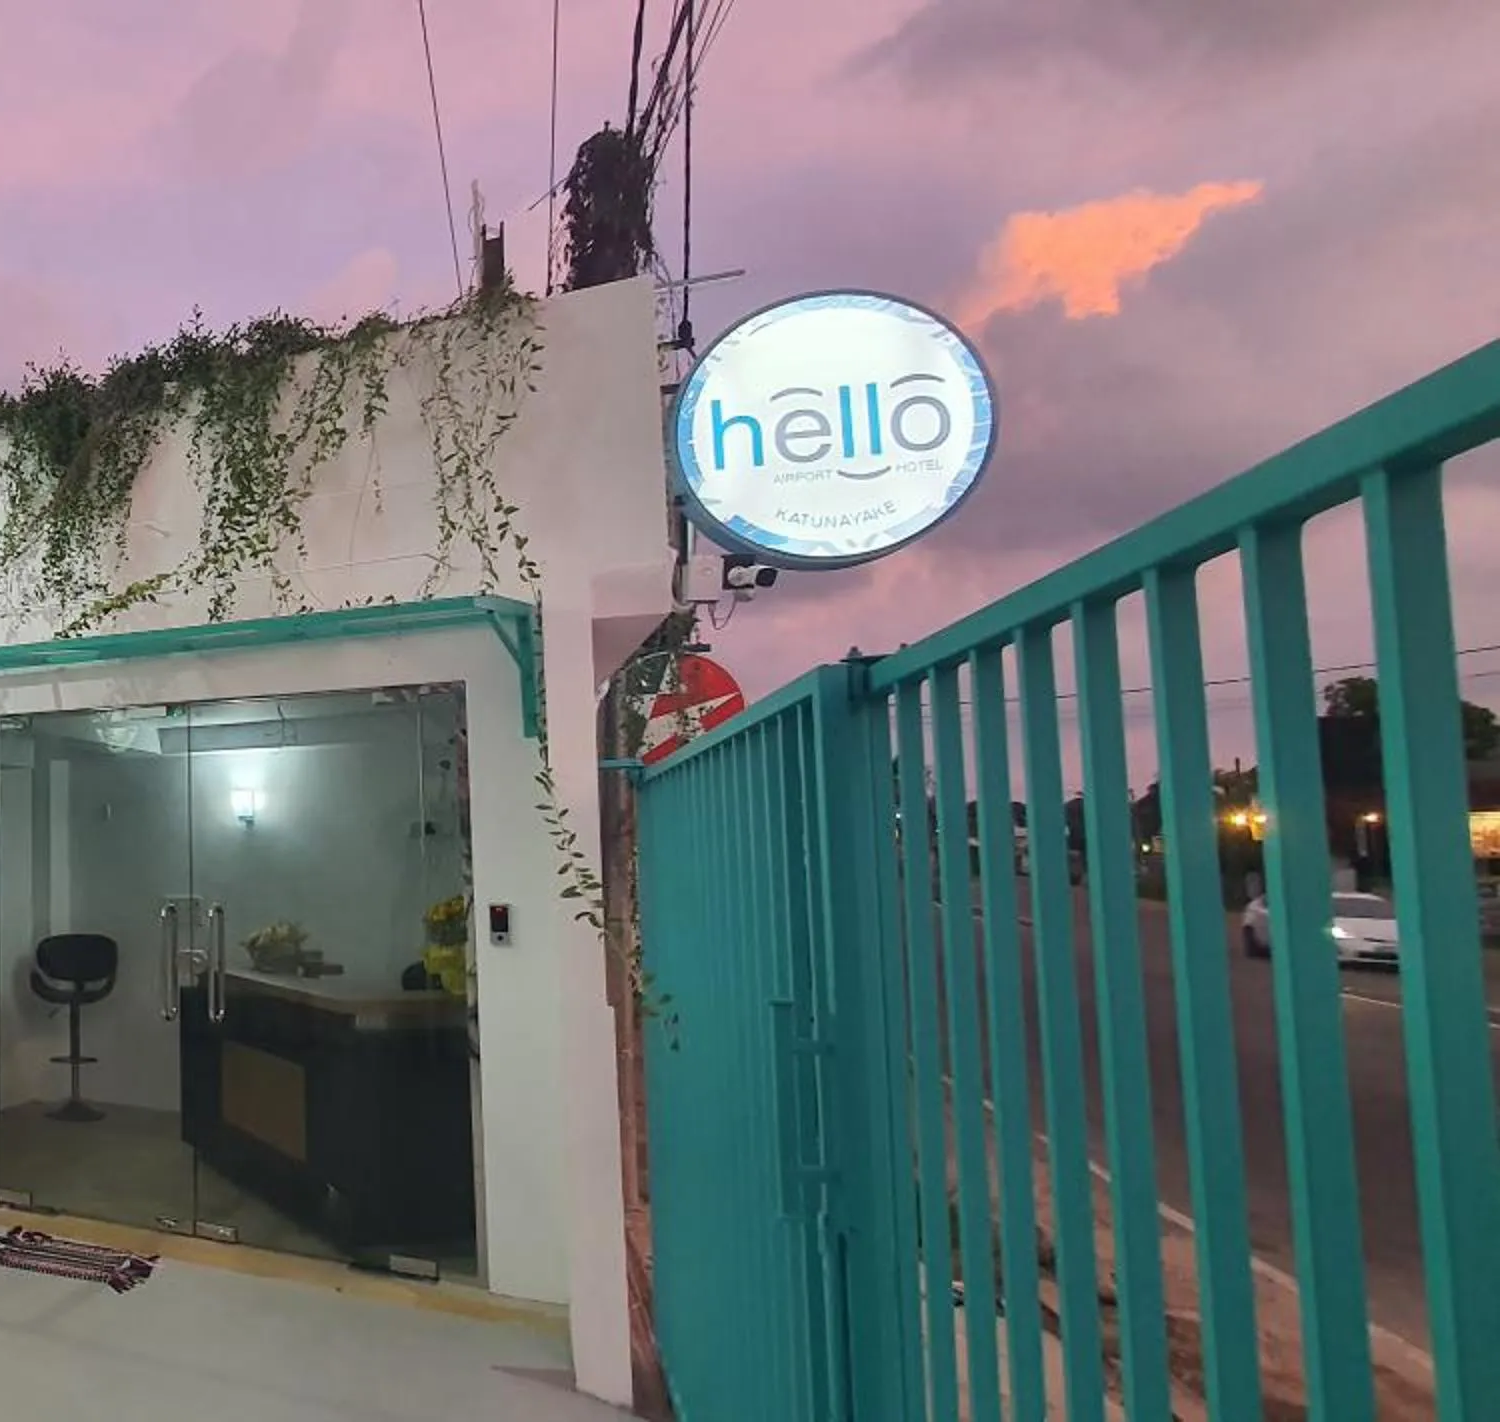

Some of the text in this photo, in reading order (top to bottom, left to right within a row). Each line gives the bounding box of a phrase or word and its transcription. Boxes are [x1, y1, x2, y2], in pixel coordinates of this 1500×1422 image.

[773, 458, 944, 485] AIRPORT HOTEL
[775, 500, 897, 529] KATUNAYAKE
